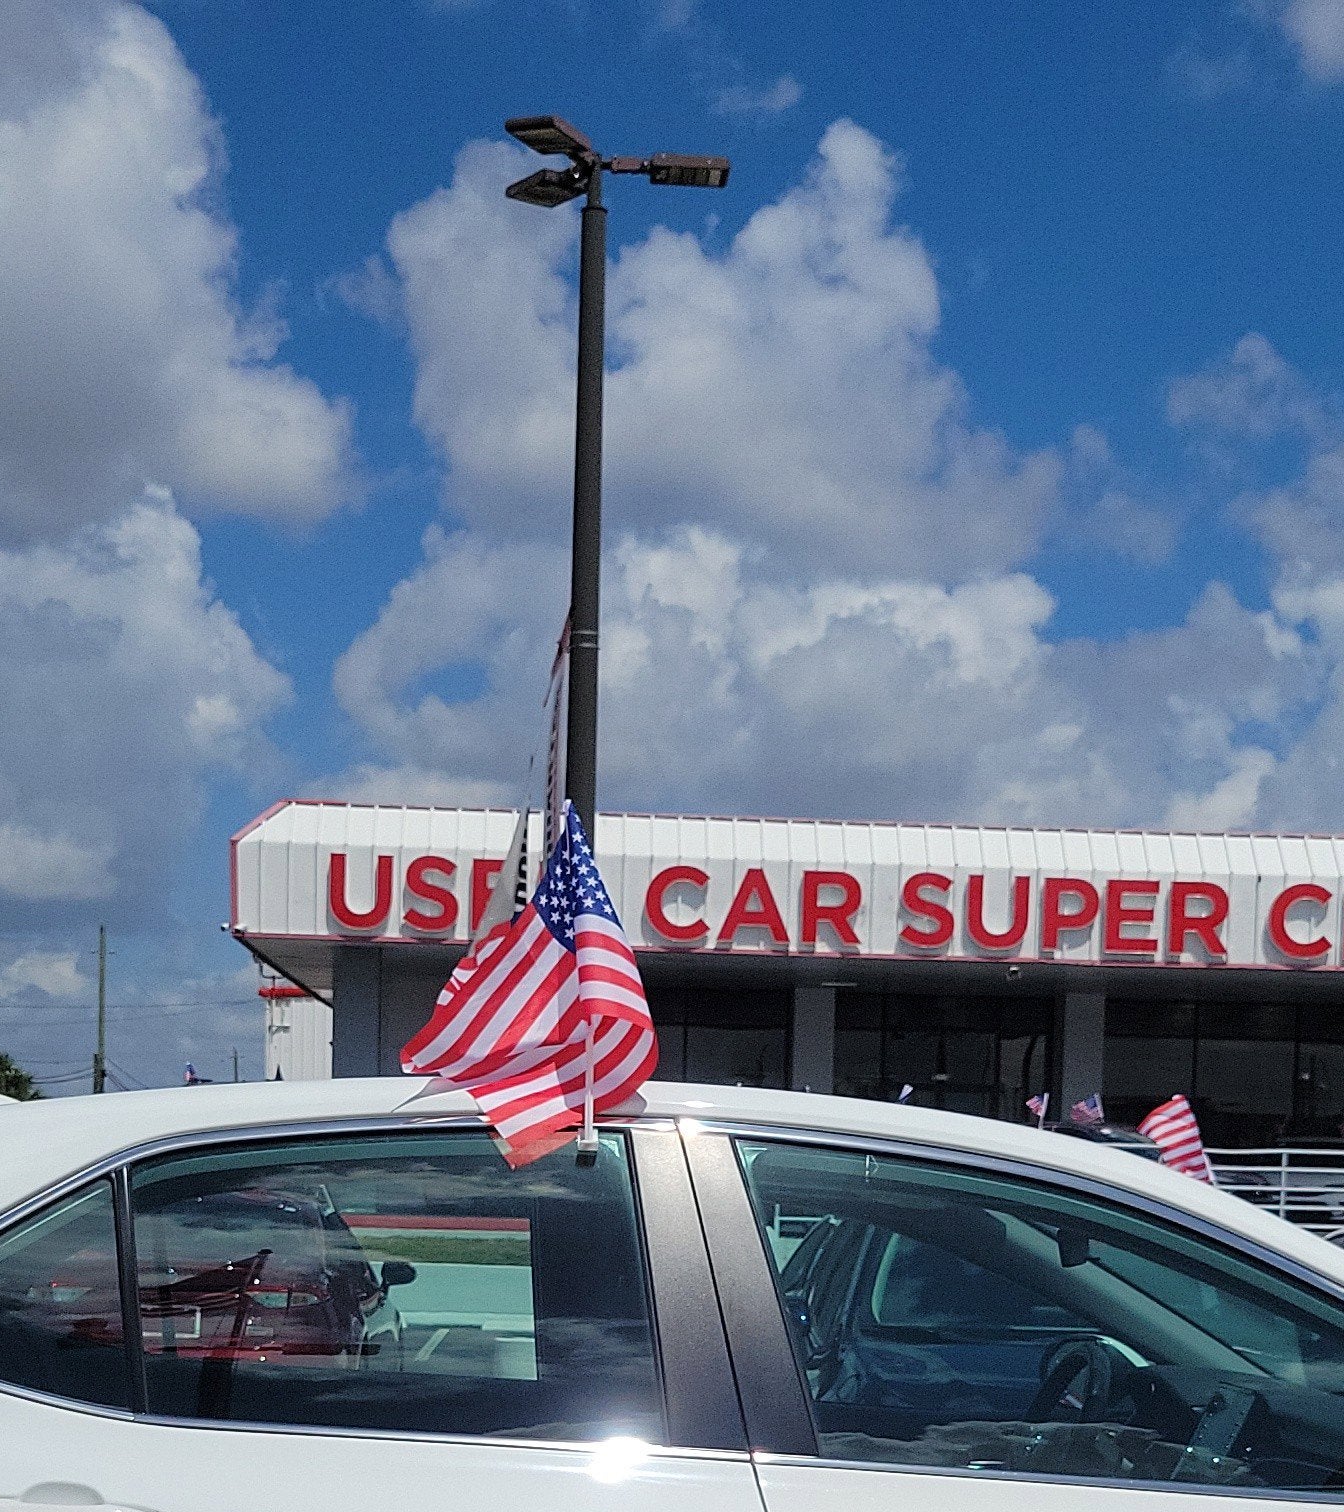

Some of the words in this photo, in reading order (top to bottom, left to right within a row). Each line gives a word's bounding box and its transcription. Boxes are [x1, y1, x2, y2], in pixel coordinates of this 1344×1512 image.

[328, 852, 506, 933] US
[645, 864, 863, 945] CAR
[899, 871, 1230, 958] SUPER
